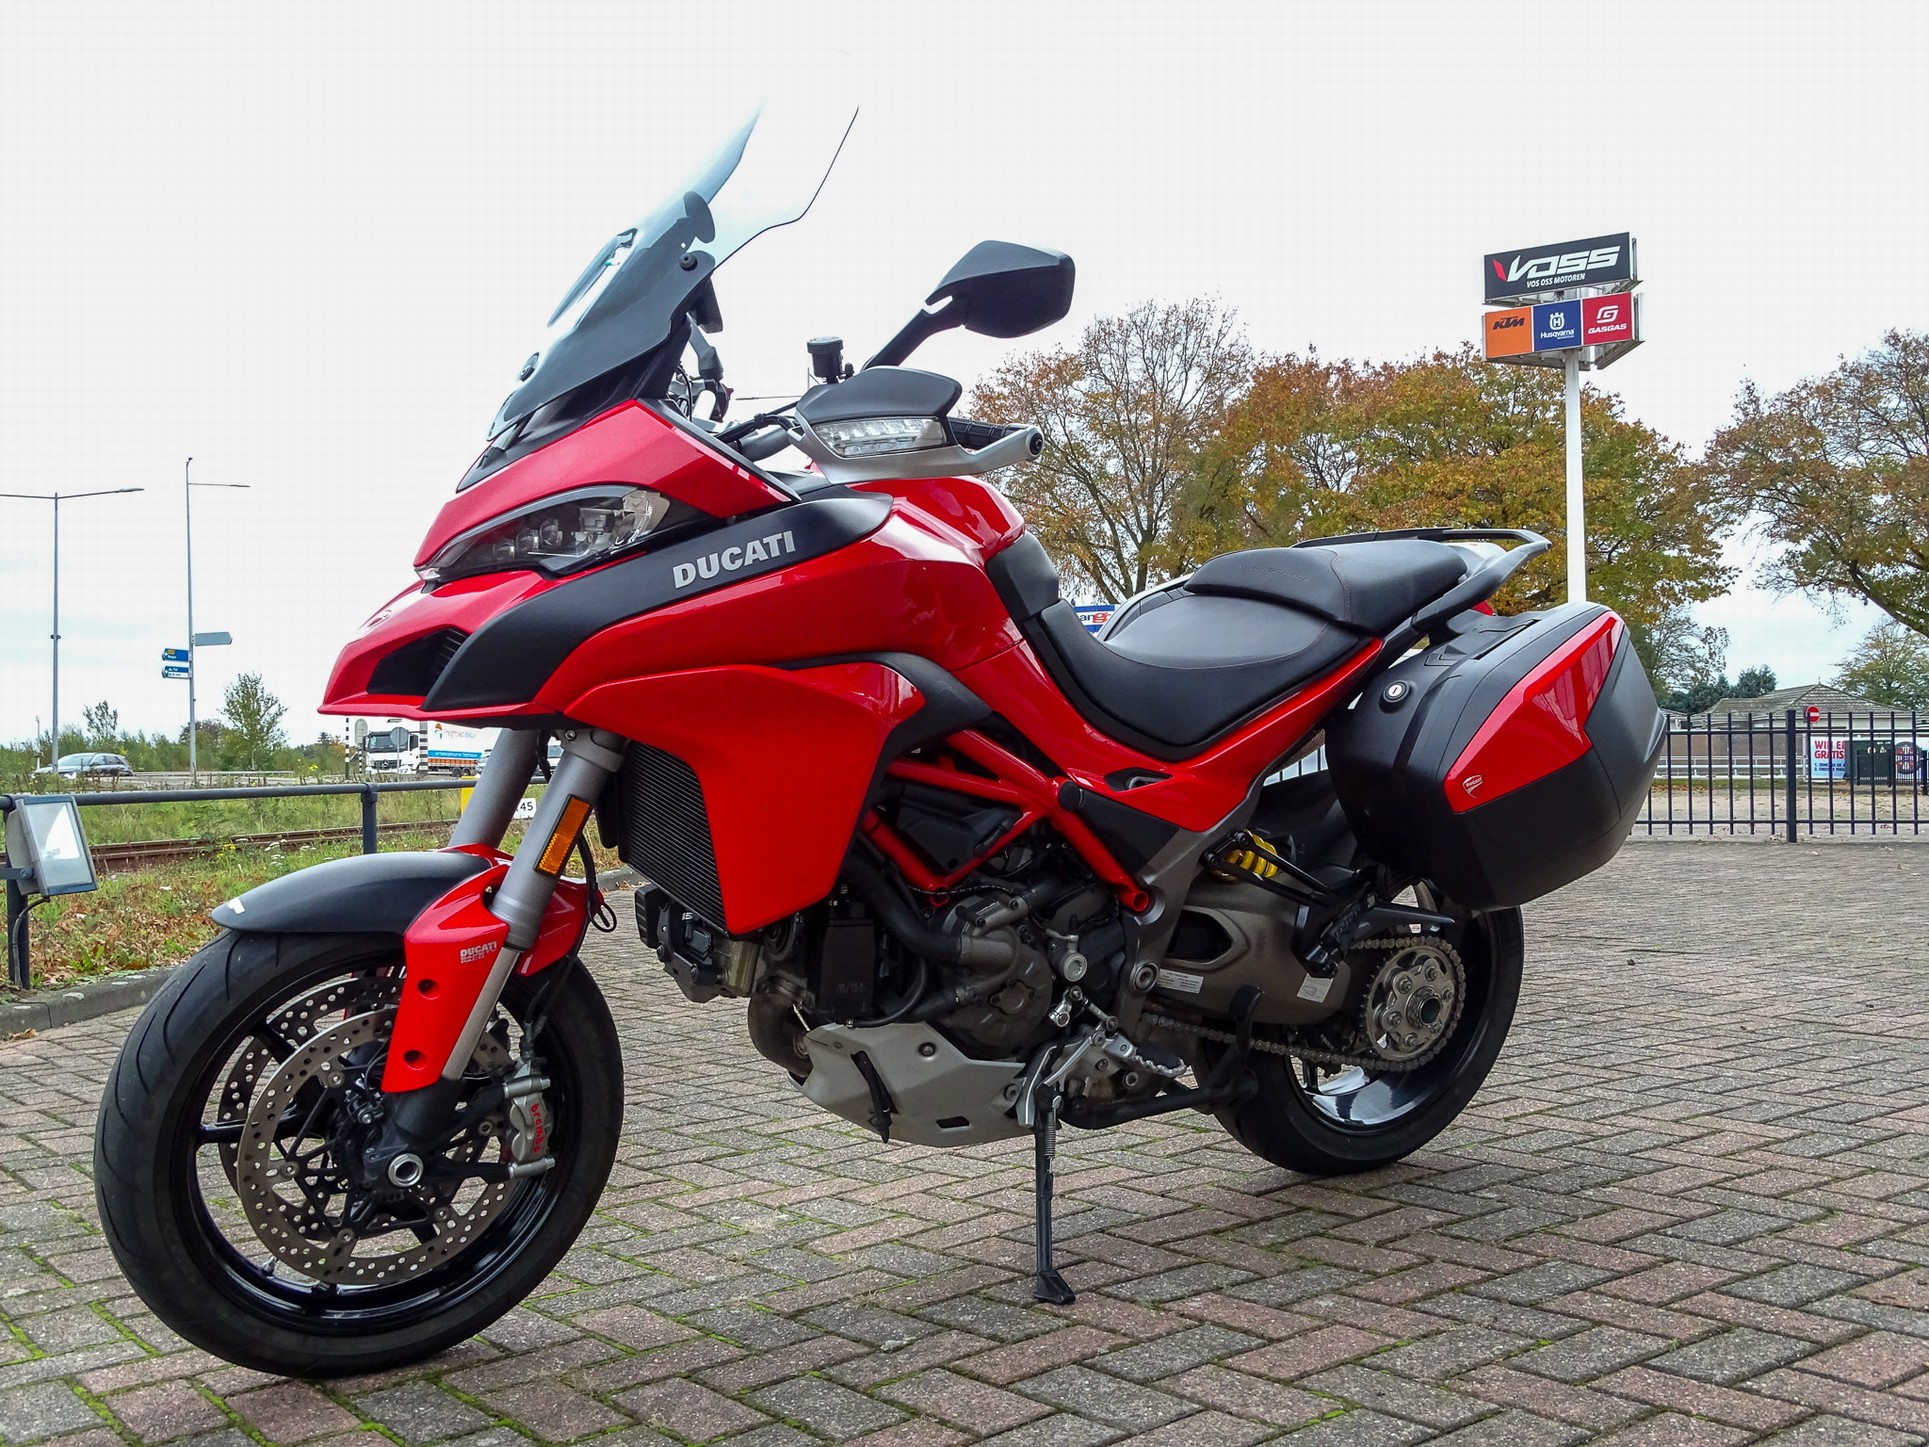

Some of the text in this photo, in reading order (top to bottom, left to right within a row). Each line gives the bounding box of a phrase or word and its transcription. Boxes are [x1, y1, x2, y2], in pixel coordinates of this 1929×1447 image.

[1492, 245, 1621, 282] VOSS
[1526, 272, 1586, 288] VOS OSS MOTOREN
[1492, 316, 1525, 330] KTM
[1587, 323, 1628, 334] GASGAS
[1540, 328, 1575, 339] Husqvarna
[672, 530, 797, 589] DUCATI
[460, 941, 498, 957] DUCATI
